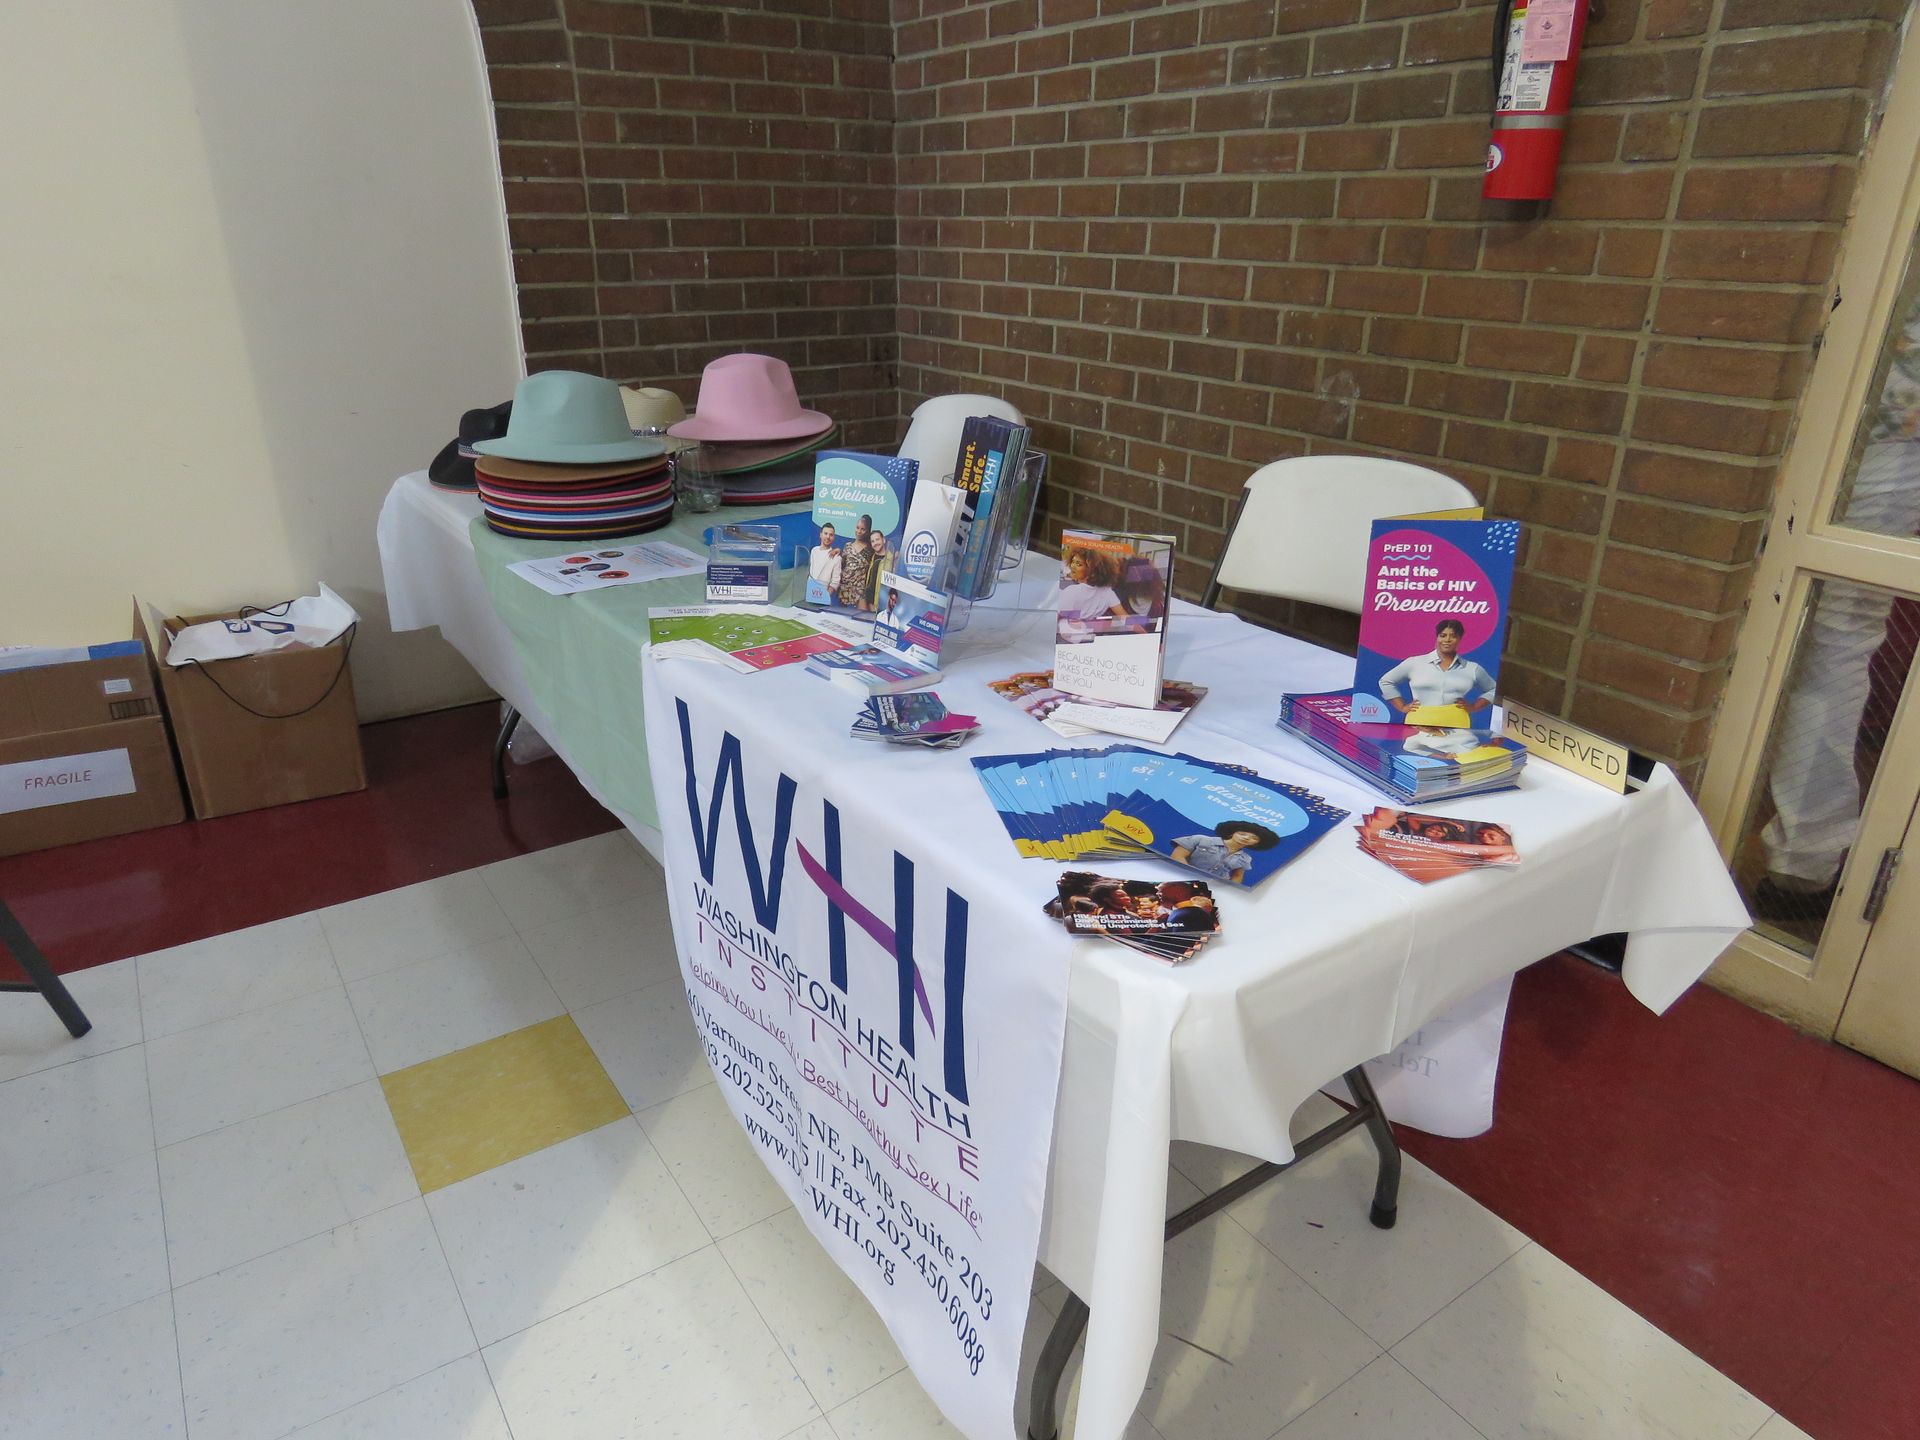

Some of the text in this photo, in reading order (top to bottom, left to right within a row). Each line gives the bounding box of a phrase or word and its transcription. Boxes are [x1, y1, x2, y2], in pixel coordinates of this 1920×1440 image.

[958, 441, 976, 489] Smart.
[969, 454, 986, 493] Safe.
[981, 457, 998, 494] WHI
[818, 486, 887, 505] & Wellness
[820, 476, 887, 490] Sexual Health
[1383, 543, 1433, 553] PrEP 101
[1376, 578, 1477, 592] Basics of HIV
[1377, 565, 1439, 577] And the
[1374, 591, 1491, 614] Prevention
[1057, 650, 1138, 674] BECAUSE NO ONE
[1058, 661, 1145, 687] TAKES CARE OF YOU
[1056, 673, 1093, 689] LIKE YOU
[1507, 711, 1620, 776] RESERVED
[24, 769, 93, 790] FRAGILE
[675, 696, 970, 1107] WHI
[694, 882, 972, 1139] WASHINGTON HEALTH
[698, 920, 980, 1182] INSTITUTE
[729, 987, 756, 1020] You
[759, 1008, 786, 1043] Live
[803, 1058, 842, 1102] Best
[846, 1090, 901, 1170] Healthy
[906, 1153, 942, 1197] Sex
[700, 1005, 765, 1074] Varnum
[807, 1111, 846, 1163] NE,
[851, 1144, 896, 1210] PMB
[900, 1200, 955, 1269] Suite
[959, 1255, 993, 1322] 203
[830, 1163, 871, 1218] Fax.
[875, 1205, 985, 1377] 202.450.6088
